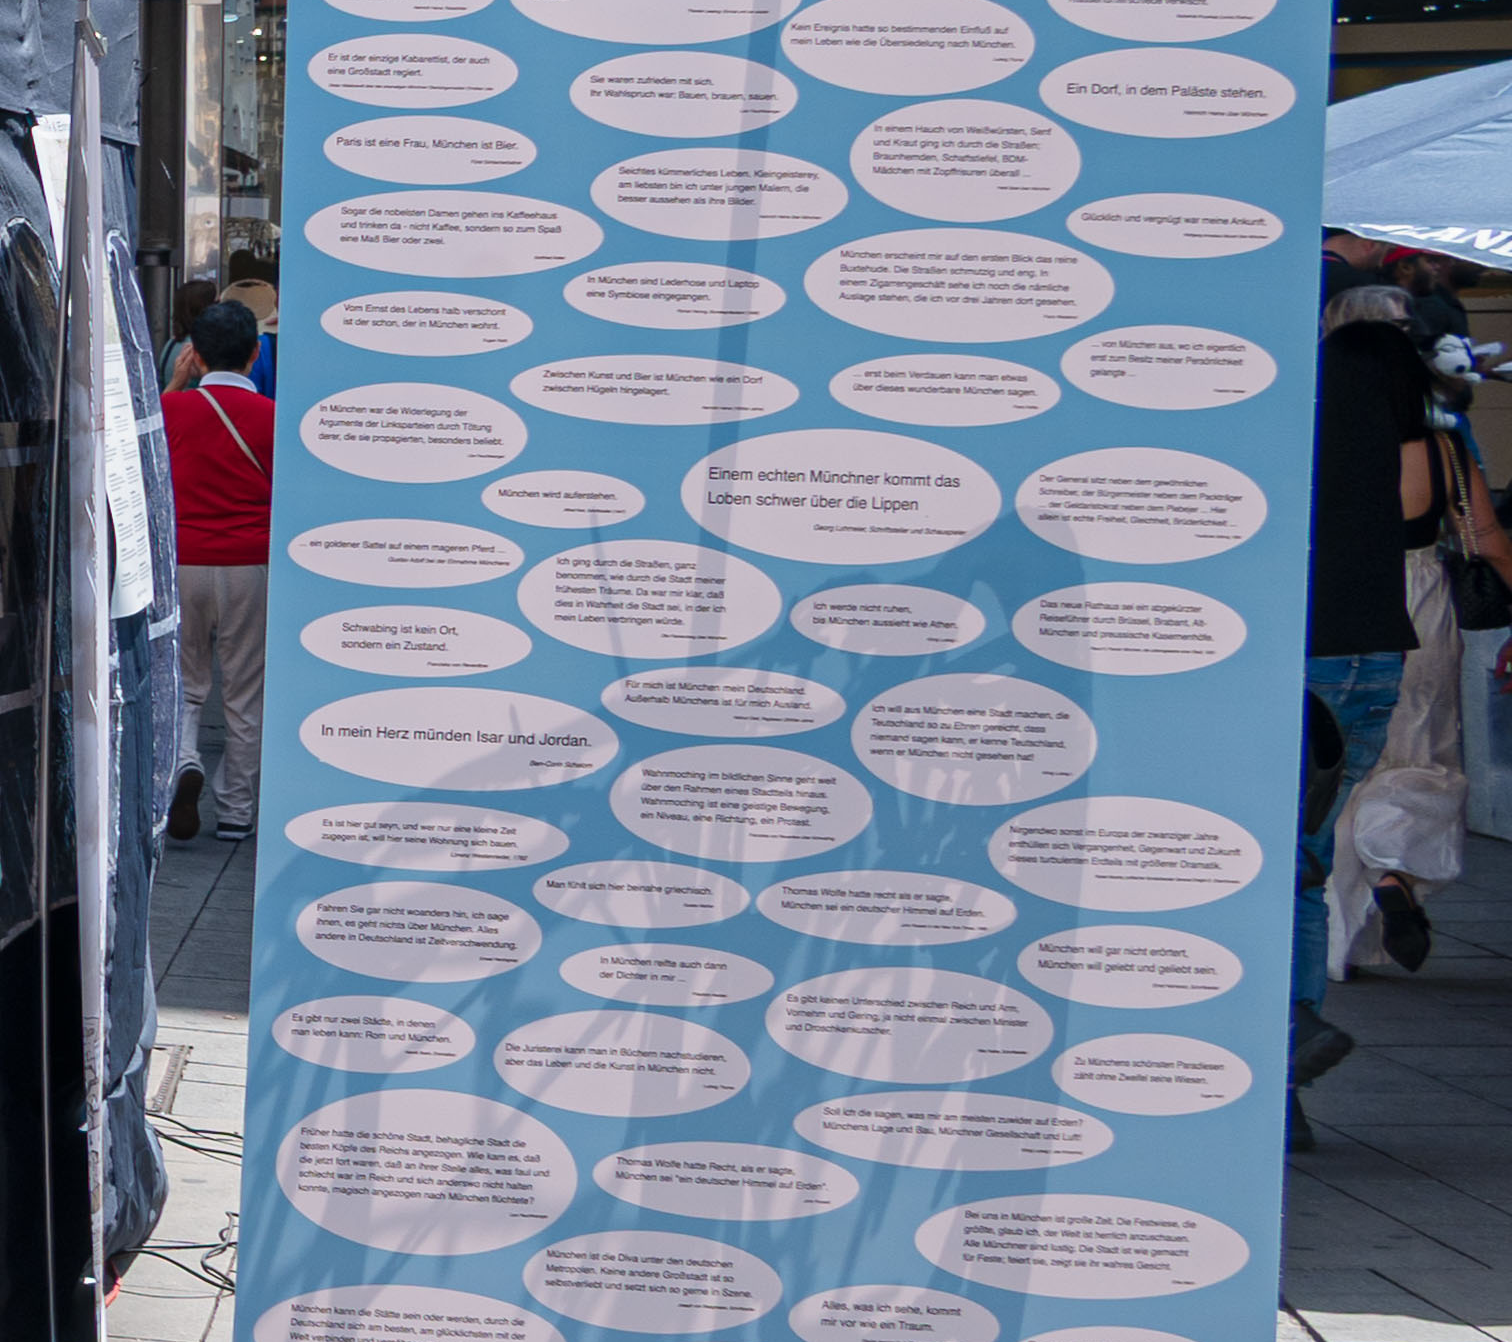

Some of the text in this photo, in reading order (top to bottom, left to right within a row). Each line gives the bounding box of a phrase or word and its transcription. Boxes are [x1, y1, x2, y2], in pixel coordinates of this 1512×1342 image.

[1066, 82, 1265, 98] Ein Dorf, in dem Paläste stehen.
[336, 136, 362, 146] Paris
[403, 138, 428, 148] Frau,
[432, 139, 478, 149] München
[496, 140, 520, 150] Bier.
[708, 466, 960, 487] Einem echten Münchner kommt das
[498, 489, 540, 497] München
[563, 491, 616, 500] auferstehen.
[708, 491, 918, 513] Loben schwer über die Lippen
[342, 622, 458, 636] Schwabing ist kein Ort,
[341, 640, 382, 649] sondern
[403, 641, 448, 651] Zustand.
[322, 724, 591, 746] In mein Herz münden Isar und Jordan.
